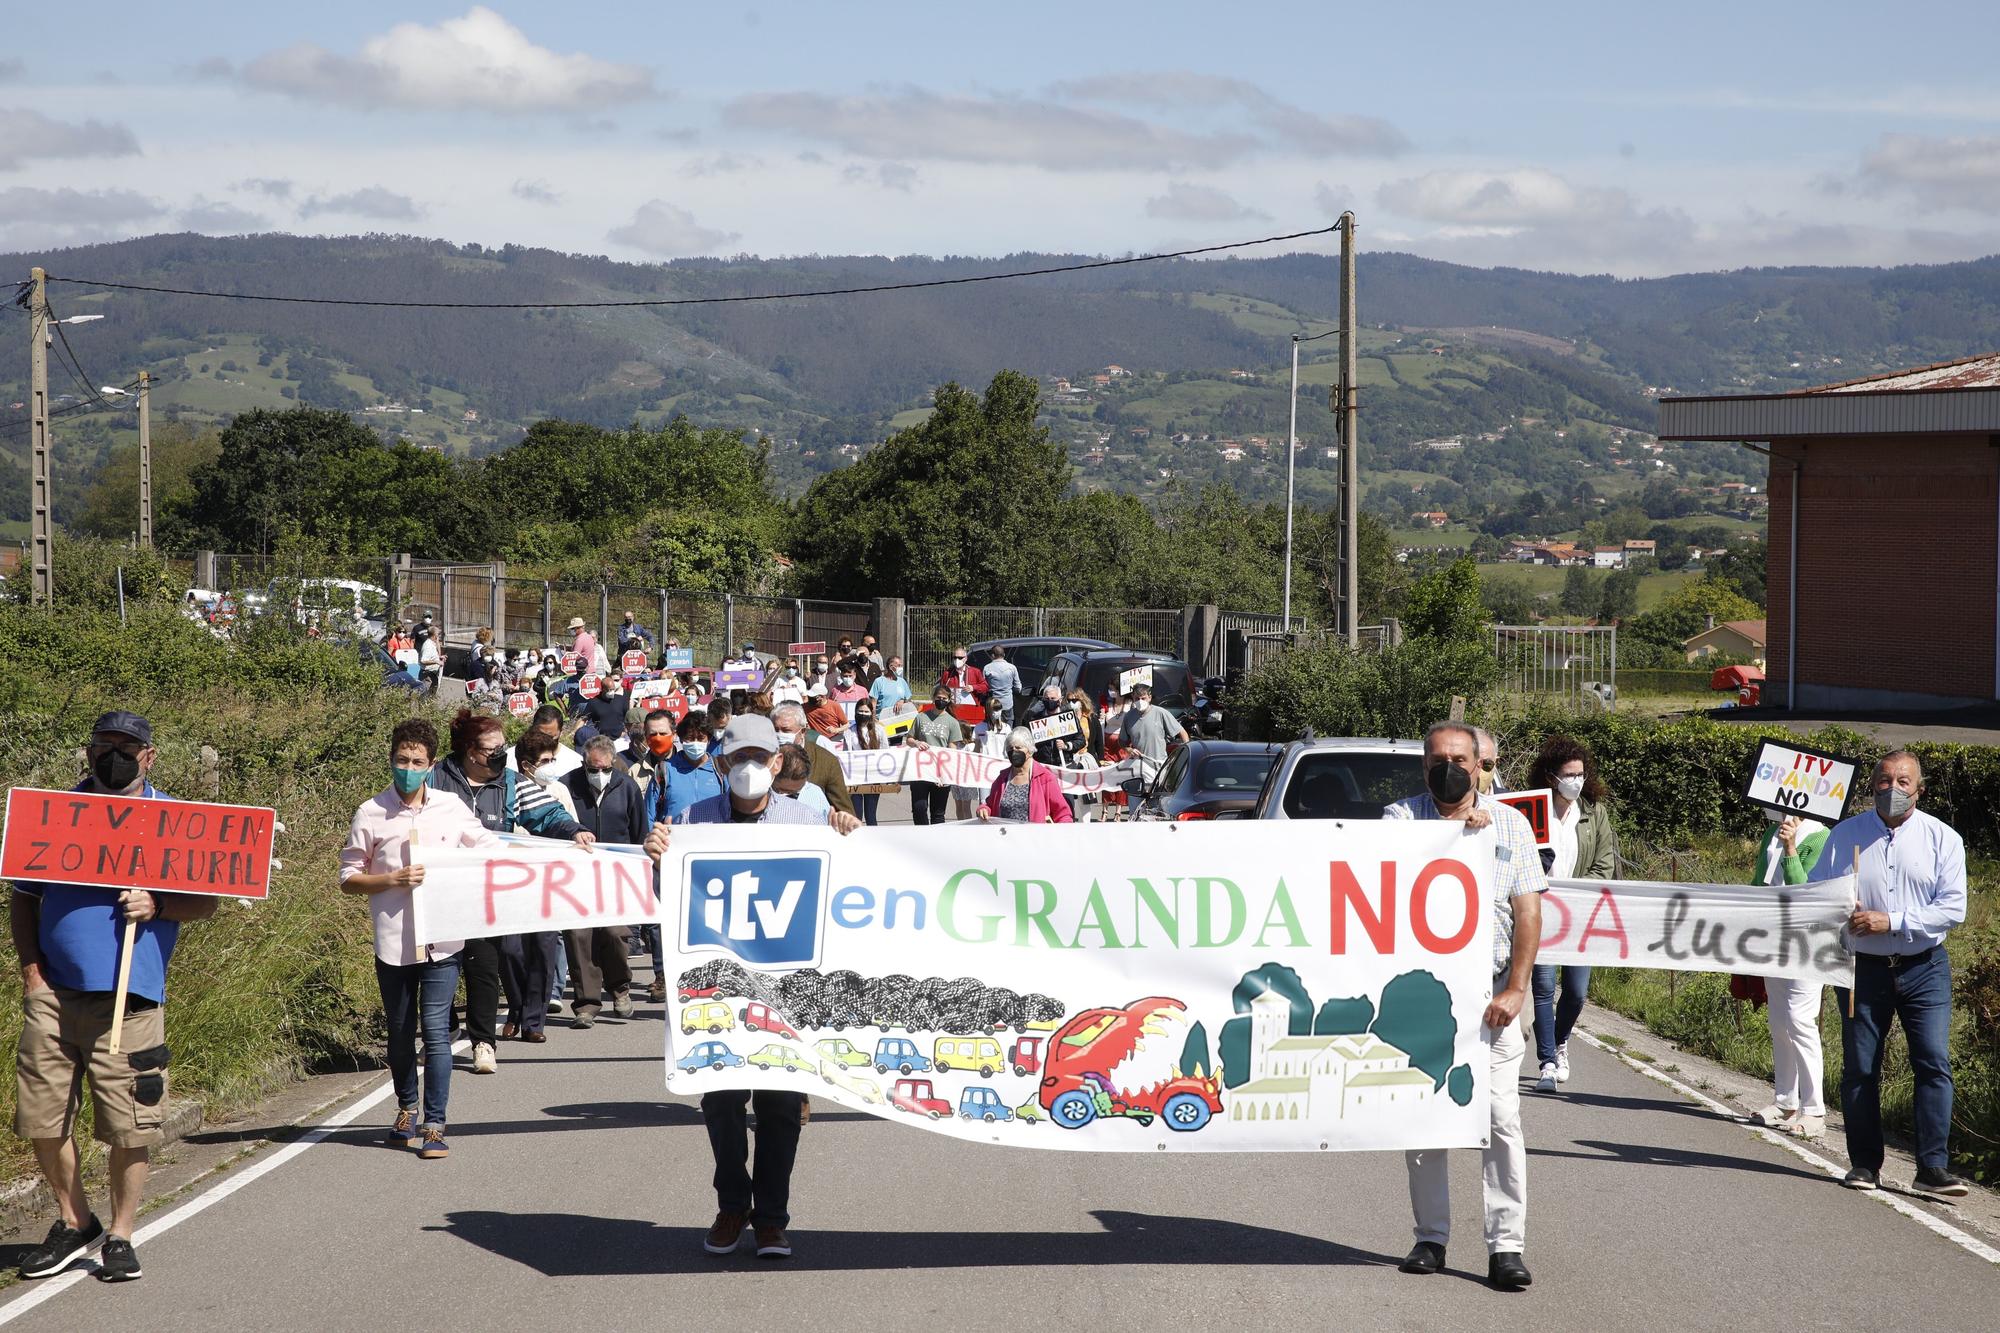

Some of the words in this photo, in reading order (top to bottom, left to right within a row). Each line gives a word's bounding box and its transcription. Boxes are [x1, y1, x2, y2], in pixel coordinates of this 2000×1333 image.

[1130, 668, 1142, 676] ITV
[1031, 719, 1048, 730] ITV
[1058, 713, 1074, 723] NO
[1793, 754, 1834, 777] ITV
[1756, 762, 1846, 801] GRANDA
[1775, 788, 1810, 810] NO
[484, 859, 655, 926] PRIN
[704, 869, 805, 941] itv
[830, 883, 927, 931] en
[935, 868, 1312, 950] GRANDA
[1329, 857, 1479, 956] NO
[1647, 892, 1853, 973] lucha
